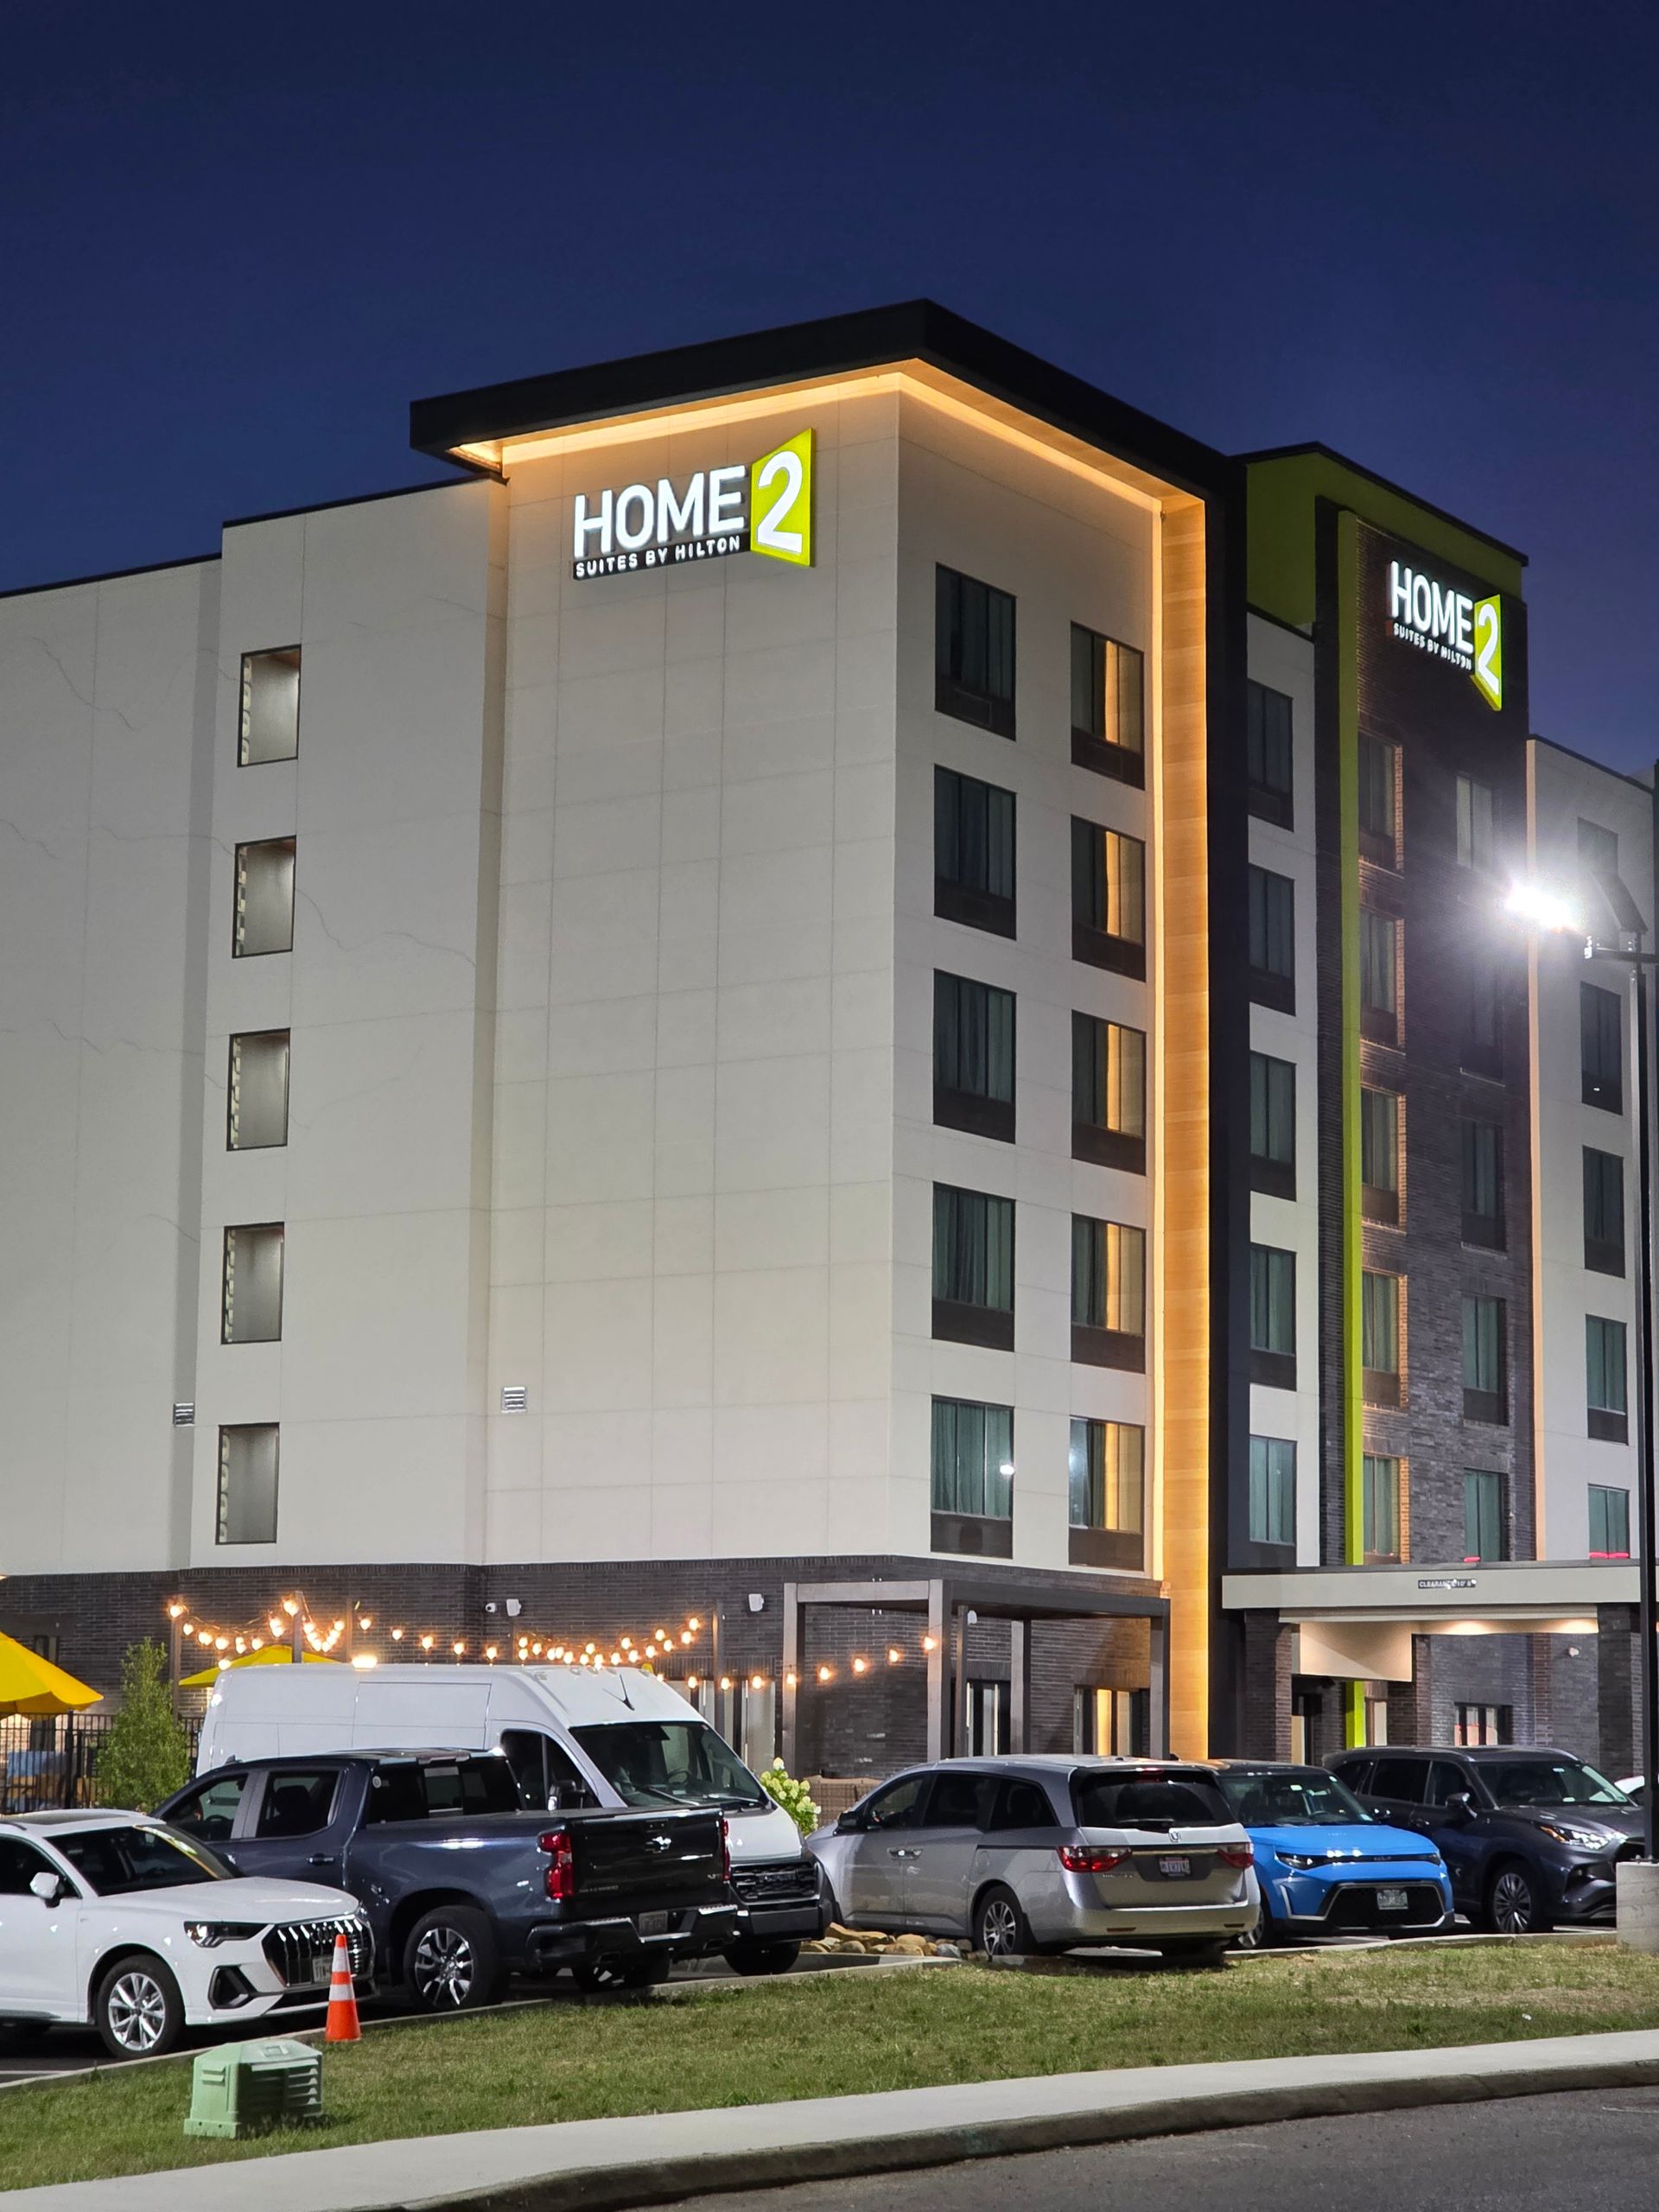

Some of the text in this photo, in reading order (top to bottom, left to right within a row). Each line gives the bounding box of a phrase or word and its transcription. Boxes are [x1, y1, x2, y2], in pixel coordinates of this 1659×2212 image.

[574, 450, 804, 560] HOME 2
[575, 535, 741, 578] SUITES BY HILTON
[1390, 560, 1500, 696] HOME 2
[1394, 622, 1472, 671] SUITES BY HILTON
